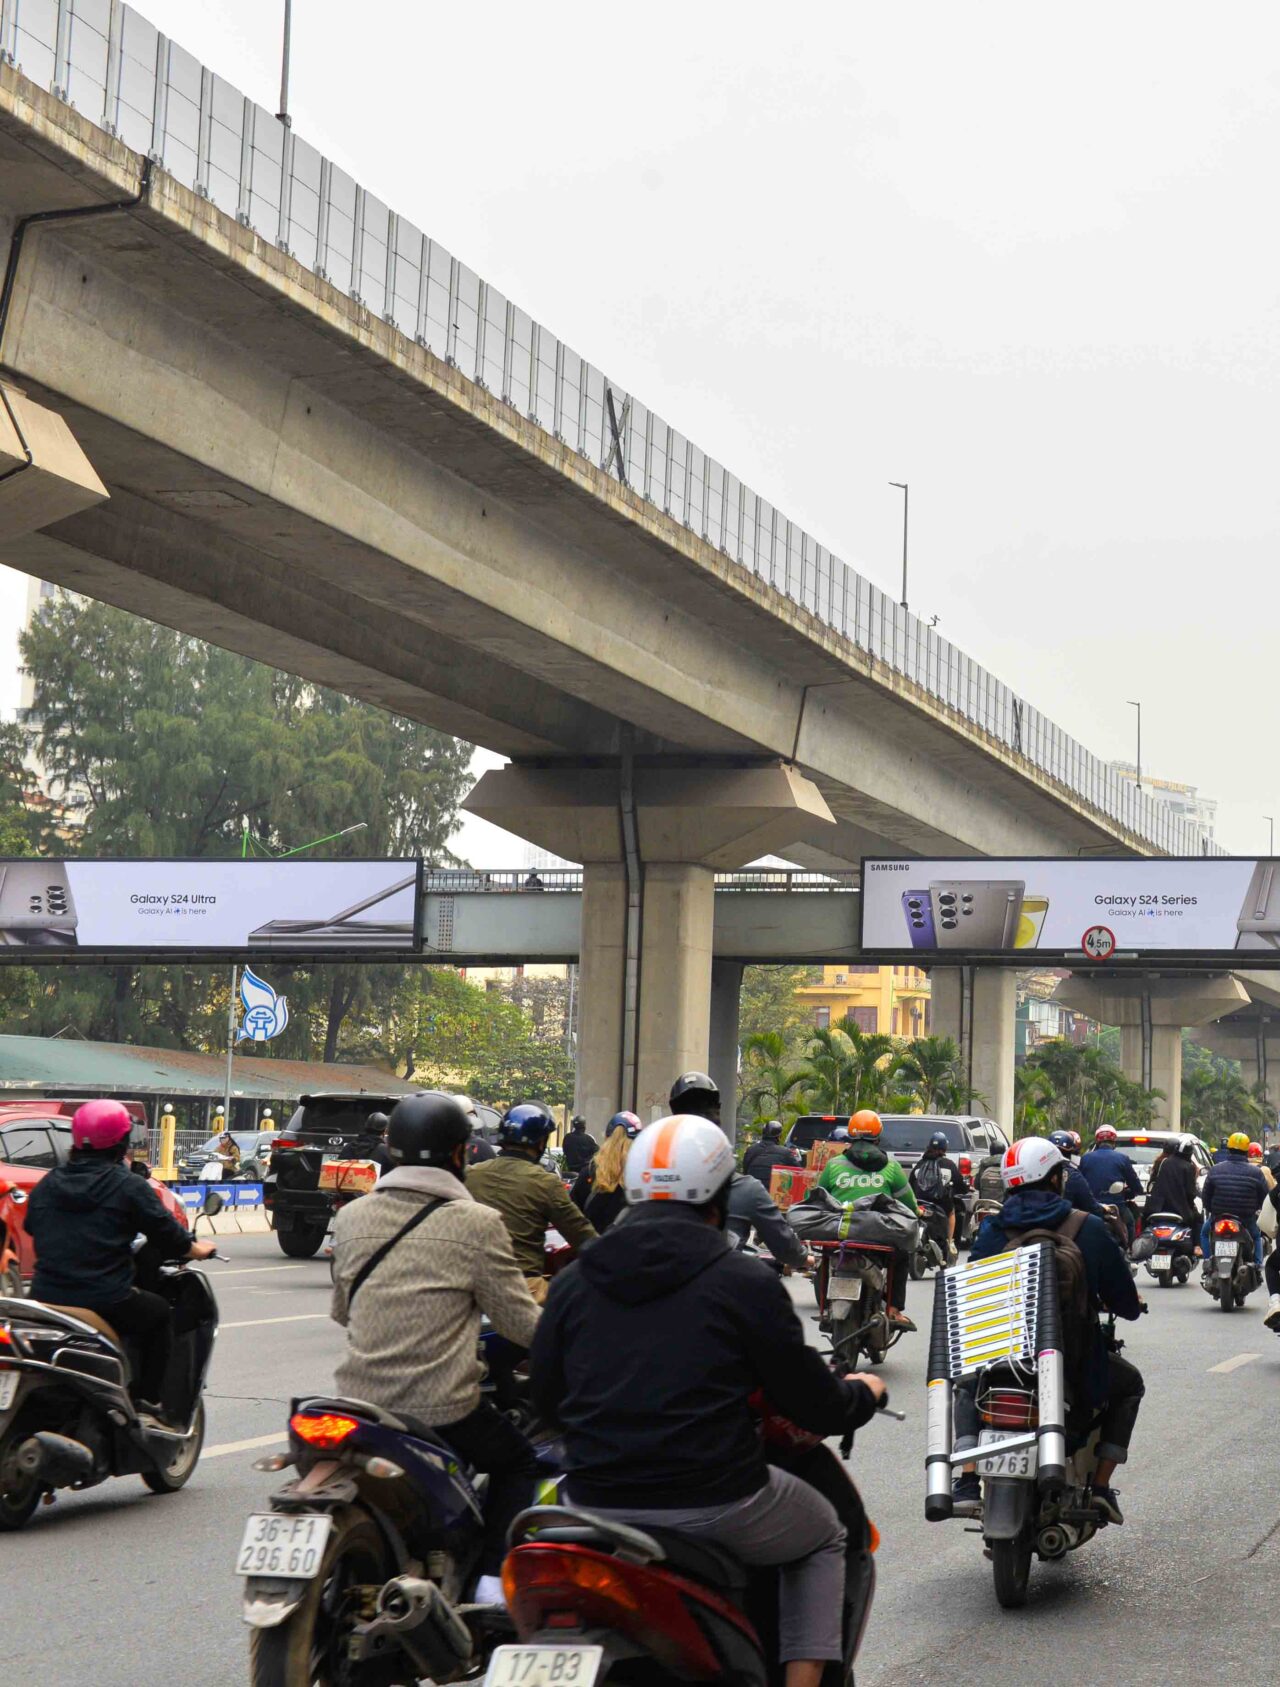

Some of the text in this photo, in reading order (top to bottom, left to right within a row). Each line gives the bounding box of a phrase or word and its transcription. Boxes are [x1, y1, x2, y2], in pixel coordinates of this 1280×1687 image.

[870, 864, 910, 872] SAMSUNG
[130, 893, 217, 906] Galaxy S24 Ultra
[1094, 894, 1198, 907] Galaxy S24 Series
[138, 907, 164, 916] Galaxy
[1108, 908, 1136, 918] Galaxy
[1155, 908, 1162, 916] is
[836, 1172, 885, 1189] Grab
[254, 1518, 316, 1544] 36-F1
[240, 1546, 317, 1573] 296.60
[508, 1652, 583, 1681] 17-B3
